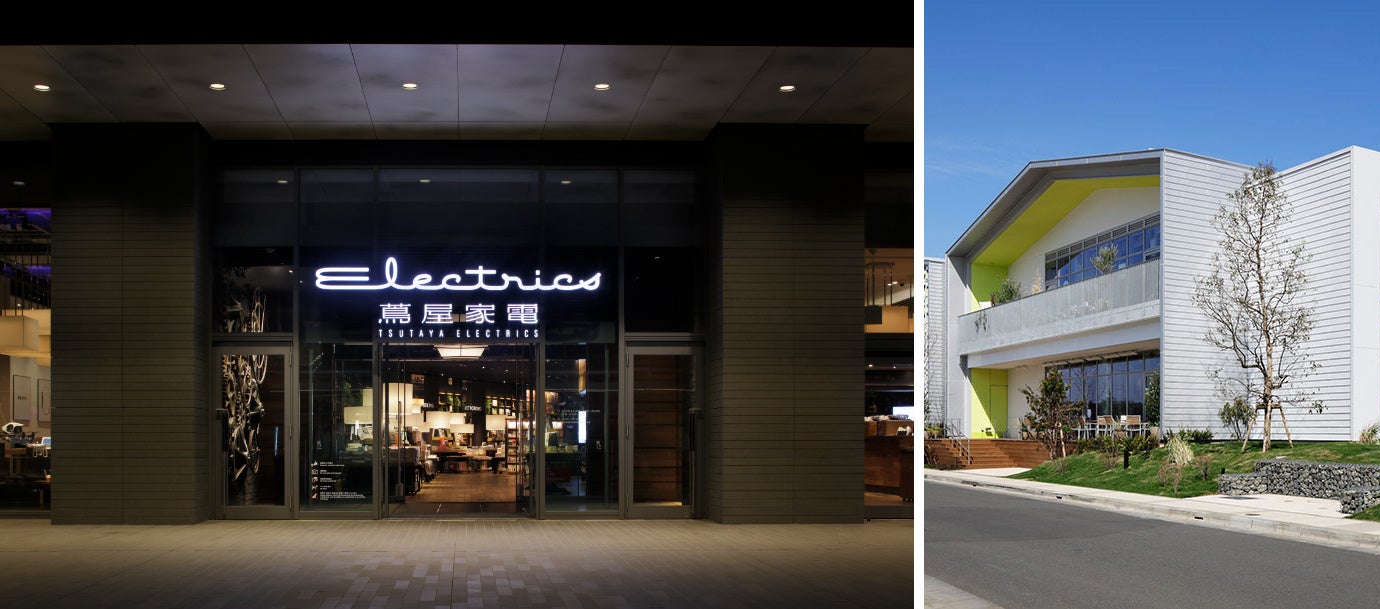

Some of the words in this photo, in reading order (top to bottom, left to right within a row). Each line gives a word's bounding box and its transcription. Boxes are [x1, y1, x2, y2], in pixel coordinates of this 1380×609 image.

[315, 256, 602, 291] Electrics
[378, 303, 538, 324] 蔦屋家電
[378, 329, 444, 338] TSUTAYA
[456, 329, 539, 338] ELECTRICS
